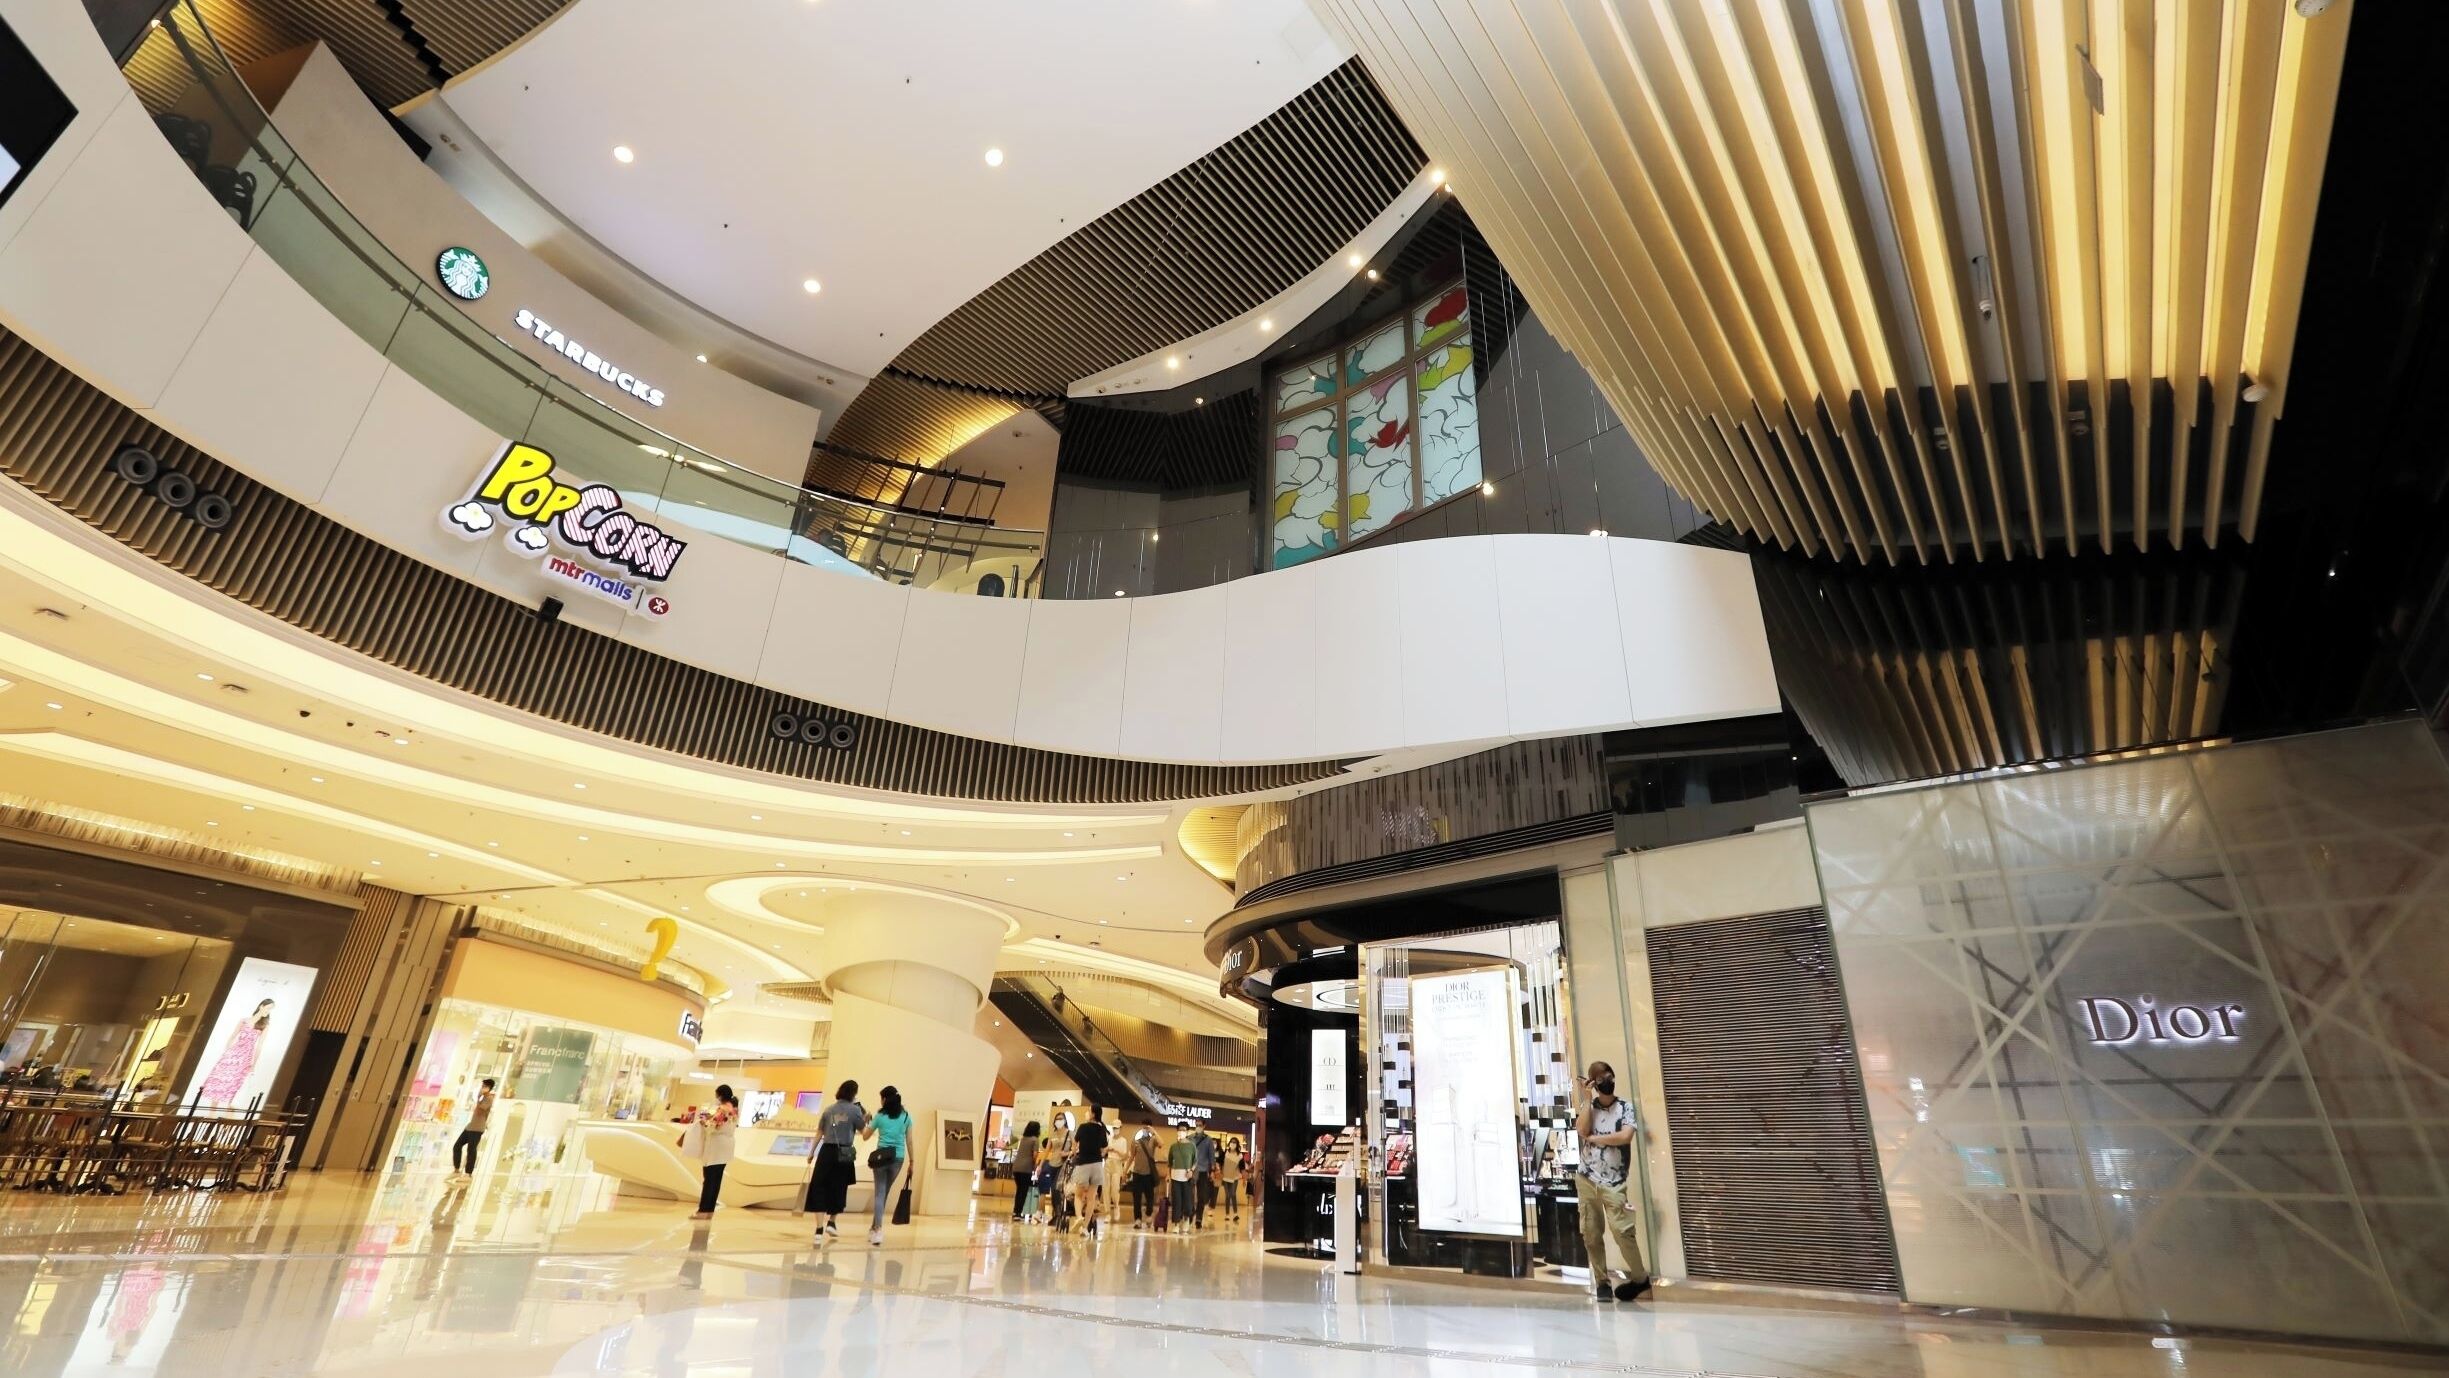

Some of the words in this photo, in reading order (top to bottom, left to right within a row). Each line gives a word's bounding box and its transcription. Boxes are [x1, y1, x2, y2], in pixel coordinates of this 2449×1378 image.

[514, 309, 665, 407] STARBUCKS
[1445, 981, 1470, 992] DIOR
[1432, 990, 1487, 1005] PRESTIGE
[2081, 993, 2243, 1042] Dior
[530, 1044, 585, 1060] Francfranc
[1187, 1106, 1212, 1119] LAUDER
